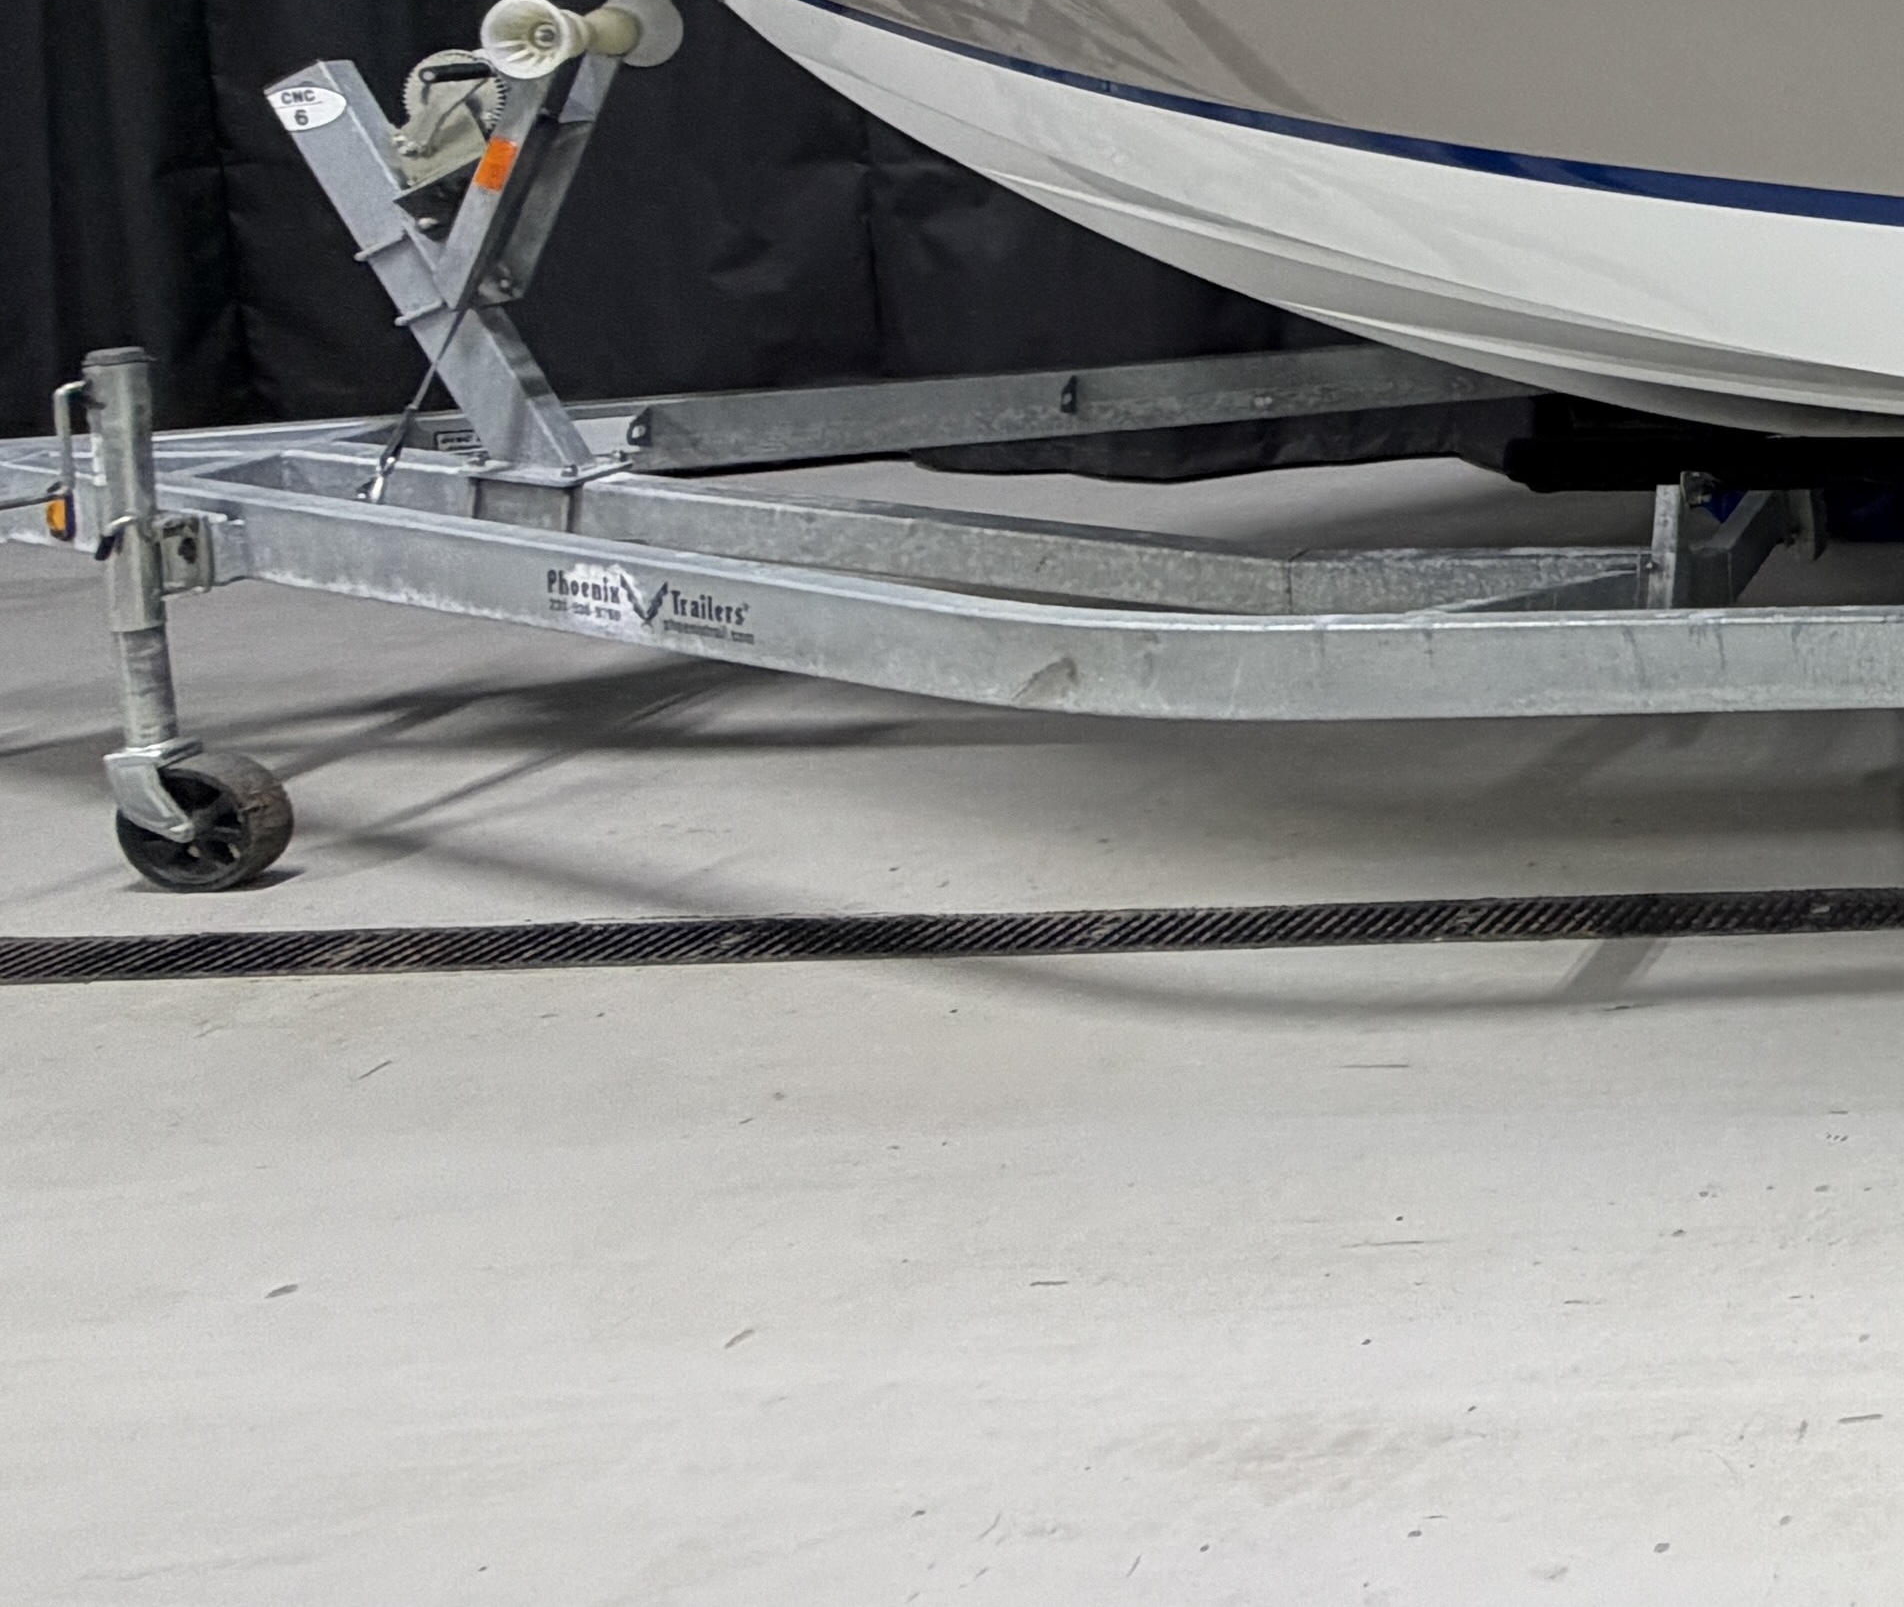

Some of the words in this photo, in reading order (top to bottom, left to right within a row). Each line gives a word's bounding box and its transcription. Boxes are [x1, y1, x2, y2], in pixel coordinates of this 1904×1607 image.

[294, 109, 309, 126] 6
[547, 569, 621, 604] Phoenix
[671, 590, 745, 626] Trailers
